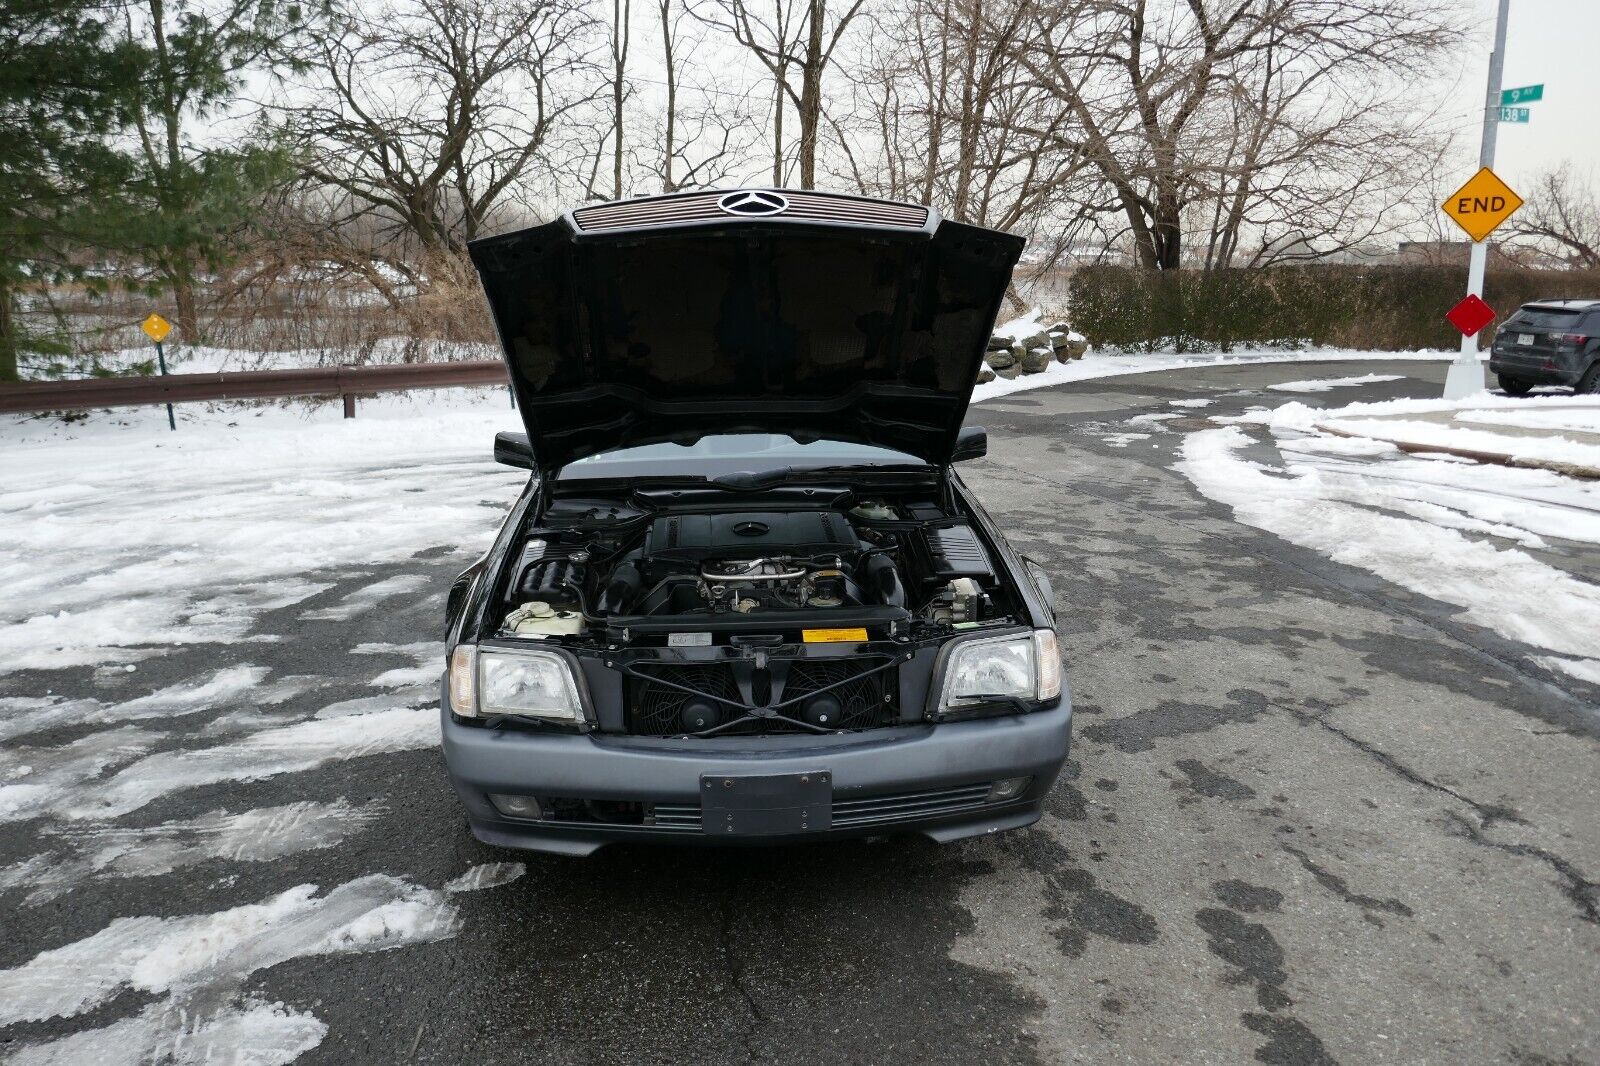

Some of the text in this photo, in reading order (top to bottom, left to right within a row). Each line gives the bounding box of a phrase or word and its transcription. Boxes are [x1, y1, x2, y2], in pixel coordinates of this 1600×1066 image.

[1511, 90, 1520, 103] 9
[1501, 108, 1518, 121] 138
[1457, 196, 1506, 214] END
